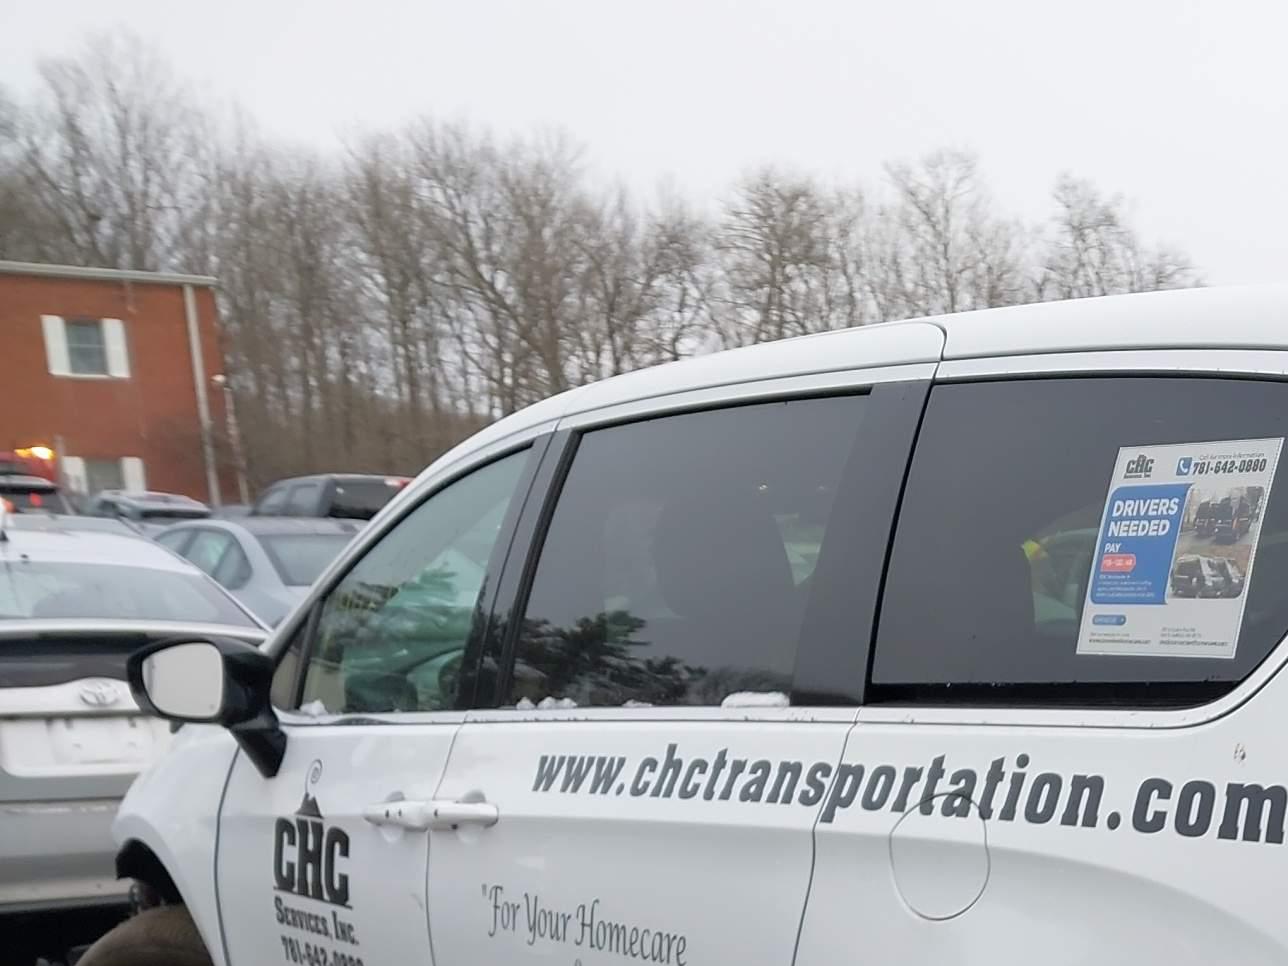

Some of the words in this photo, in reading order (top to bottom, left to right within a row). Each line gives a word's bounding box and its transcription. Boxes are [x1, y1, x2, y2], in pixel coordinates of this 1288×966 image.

[1192, 459, 1267, 476] 781-642-0880
[1112, 497, 1180, 518] DRIVERS
[1108, 519, 1170, 537] NEEDED
[1104, 543, 1122, 553] PAY
[532, 743, 1288, 844] www.chctransportation.com
[274, 816, 350, 904] CHC
[524, 892, 572, 946] Your
